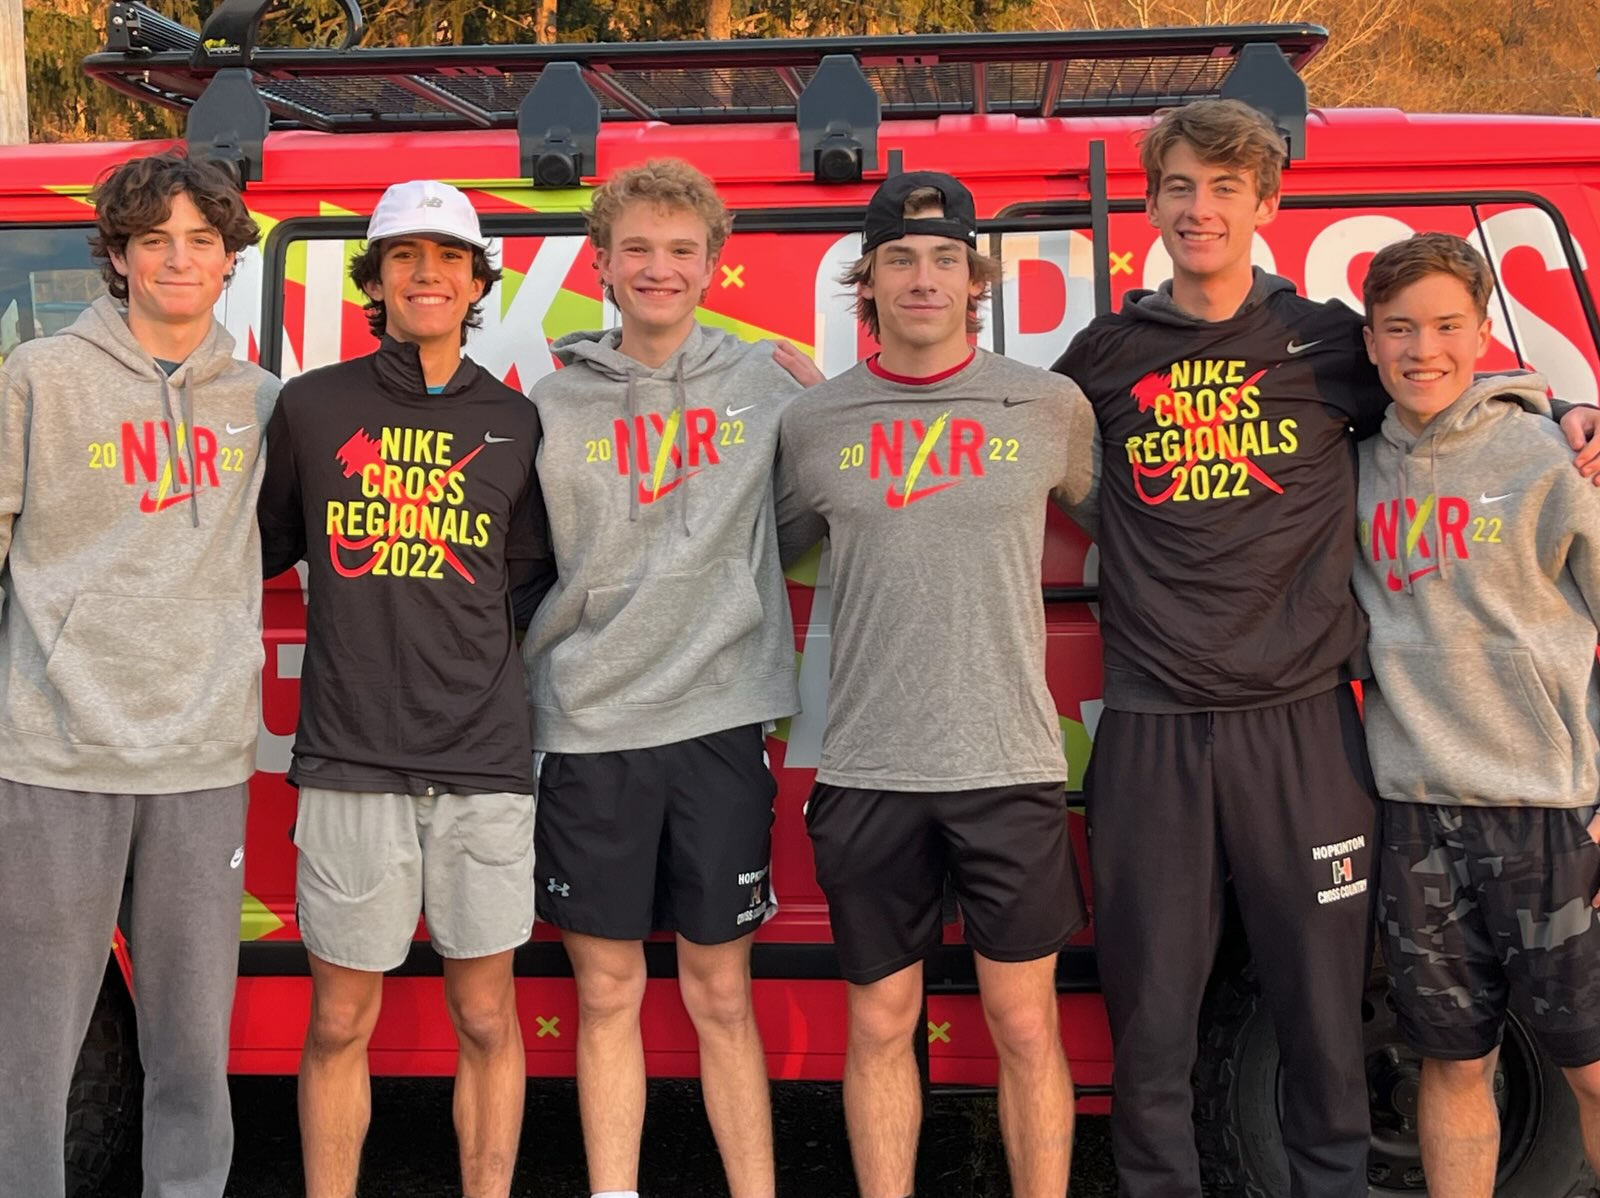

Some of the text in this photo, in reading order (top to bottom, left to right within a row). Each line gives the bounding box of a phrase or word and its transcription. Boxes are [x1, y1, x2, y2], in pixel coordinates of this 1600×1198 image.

[1170, 360, 1246, 389] NIKE
[1154, 385, 1260, 427] CROSS
[88, 442, 117, 469] 20
[221, 447, 245, 472] 22
[380, 427, 454, 466] NIKE
[585, 406, 745, 476] 20 NXR 22
[839, 415, 1020, 481] 20 NXR 22
[1125, 418, 1298, 464] REGIONALS
[361, 463, 466, 505] CROSS
[1171, 462, 1250, 501] 2022
[326, 500, 491, 548] REGIONALS
[1371, 493, 1470, 561] NXR
[1472, 516, 1503, 543] 22
[371, 541, 446, 580] 2022
[1312, 835, 1365, 860] HOPKINTON
[1317, 887, 1340, 904] CROSS
